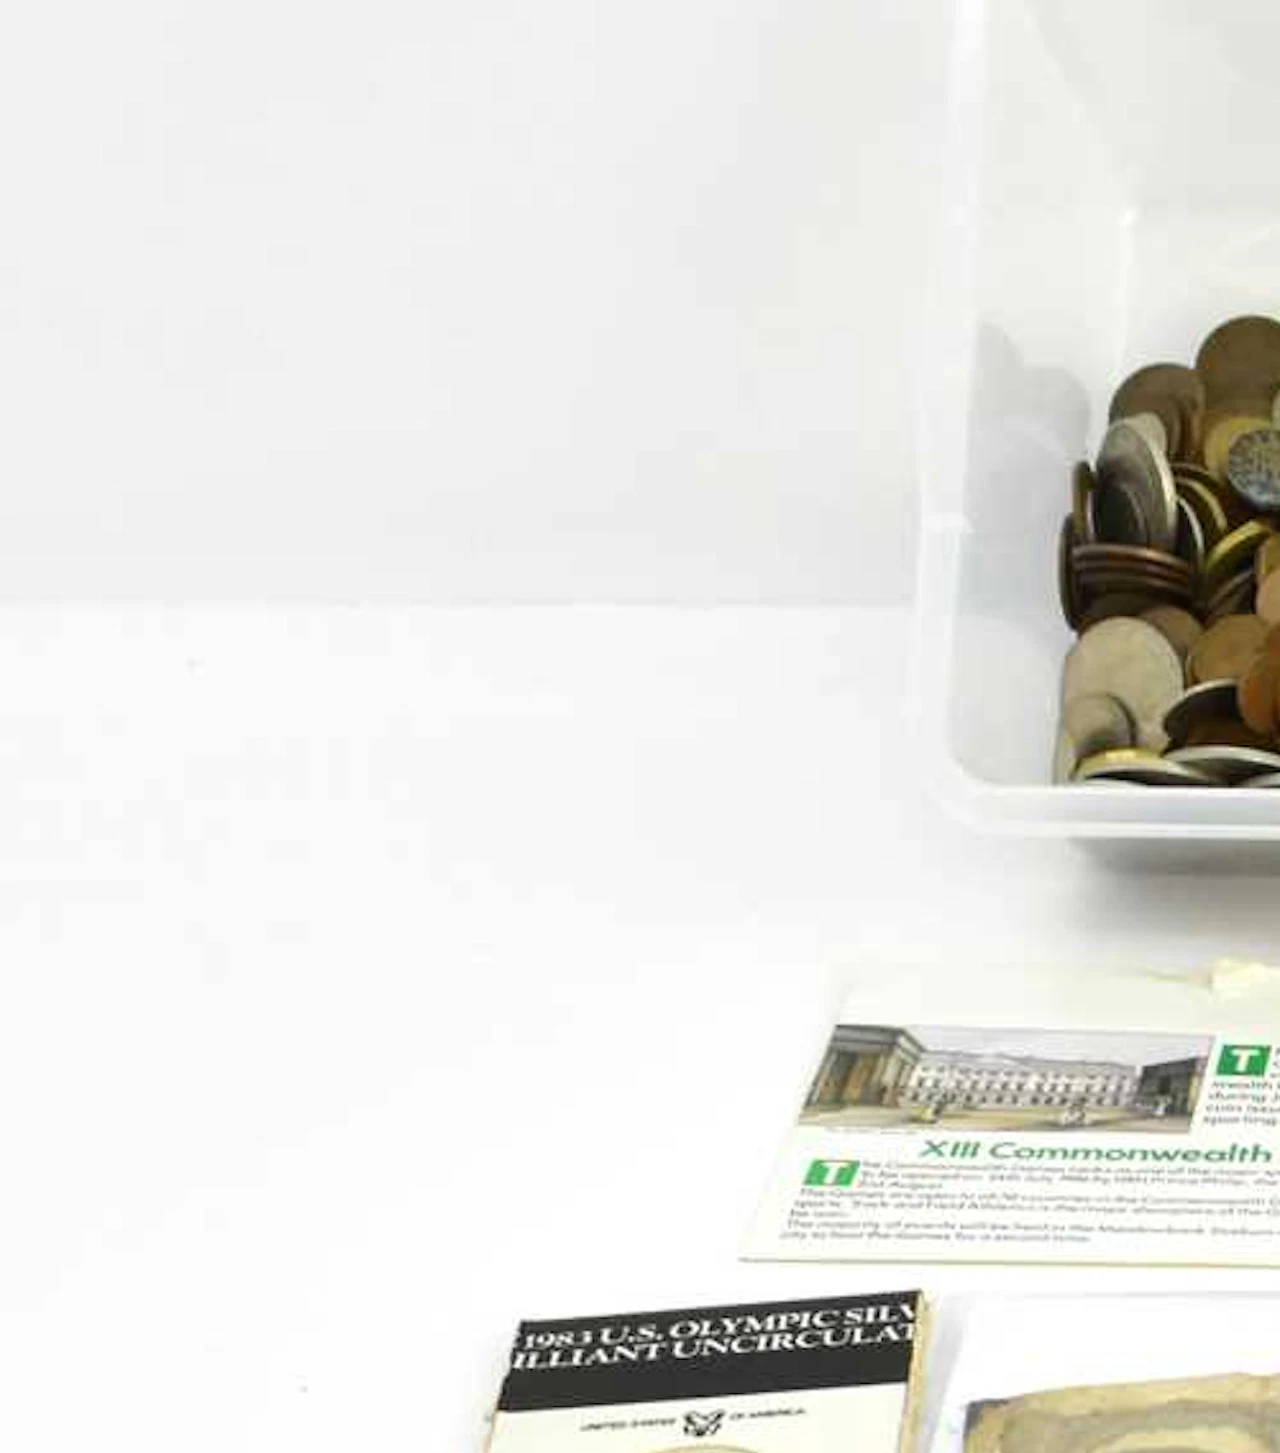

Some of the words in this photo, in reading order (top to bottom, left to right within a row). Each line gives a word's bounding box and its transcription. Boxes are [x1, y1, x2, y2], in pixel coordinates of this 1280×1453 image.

[919, 1139, 981, 1159] XIII
[988, 1141, 1273, 1163] Commonwealth
[598, 1322, 666, 1346] U.S.
[668, 1308, 840, 1342] OLYMPIC
[511, 1341, 669, 1370] ILLIANT
[671, 1323, 915, 1360] UNCIRCULAT
